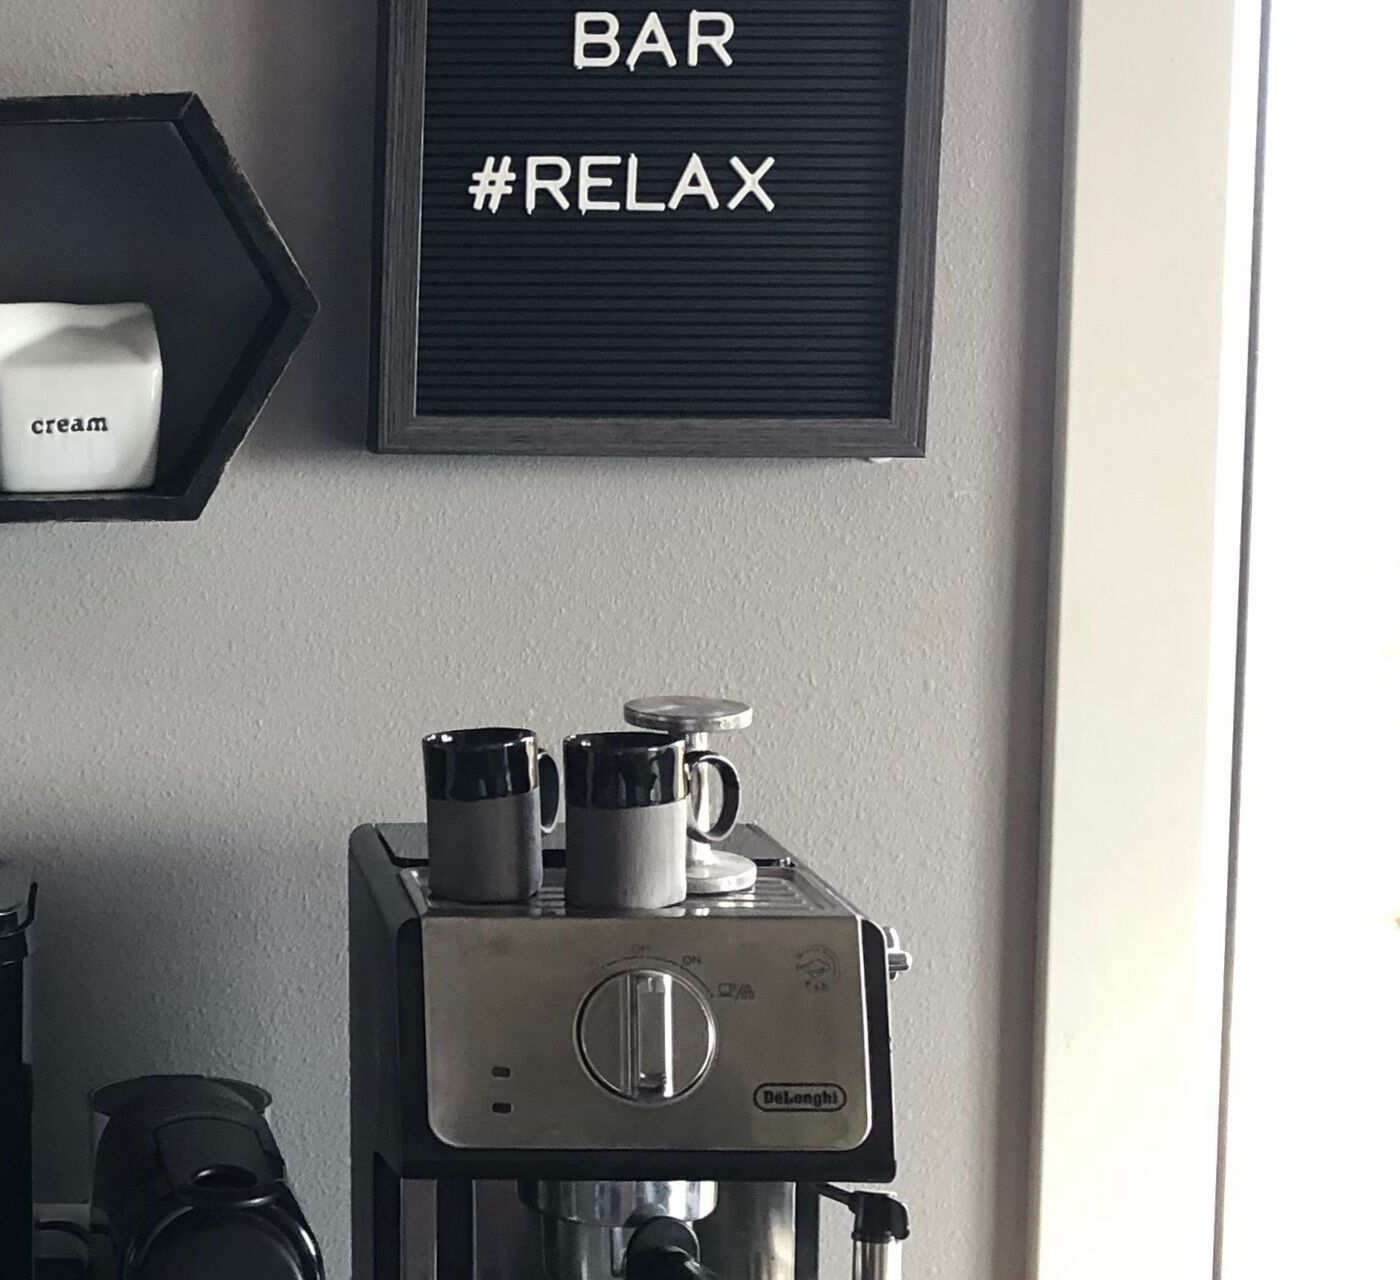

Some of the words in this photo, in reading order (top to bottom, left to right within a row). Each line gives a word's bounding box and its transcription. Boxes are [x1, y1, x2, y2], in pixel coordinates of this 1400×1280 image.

[573, 9, 735, 72] BAR
[468, 152, 776, 216] #RELAX
[30, 416, 109, 435] cream
[682, 954, 702, 967] ON
